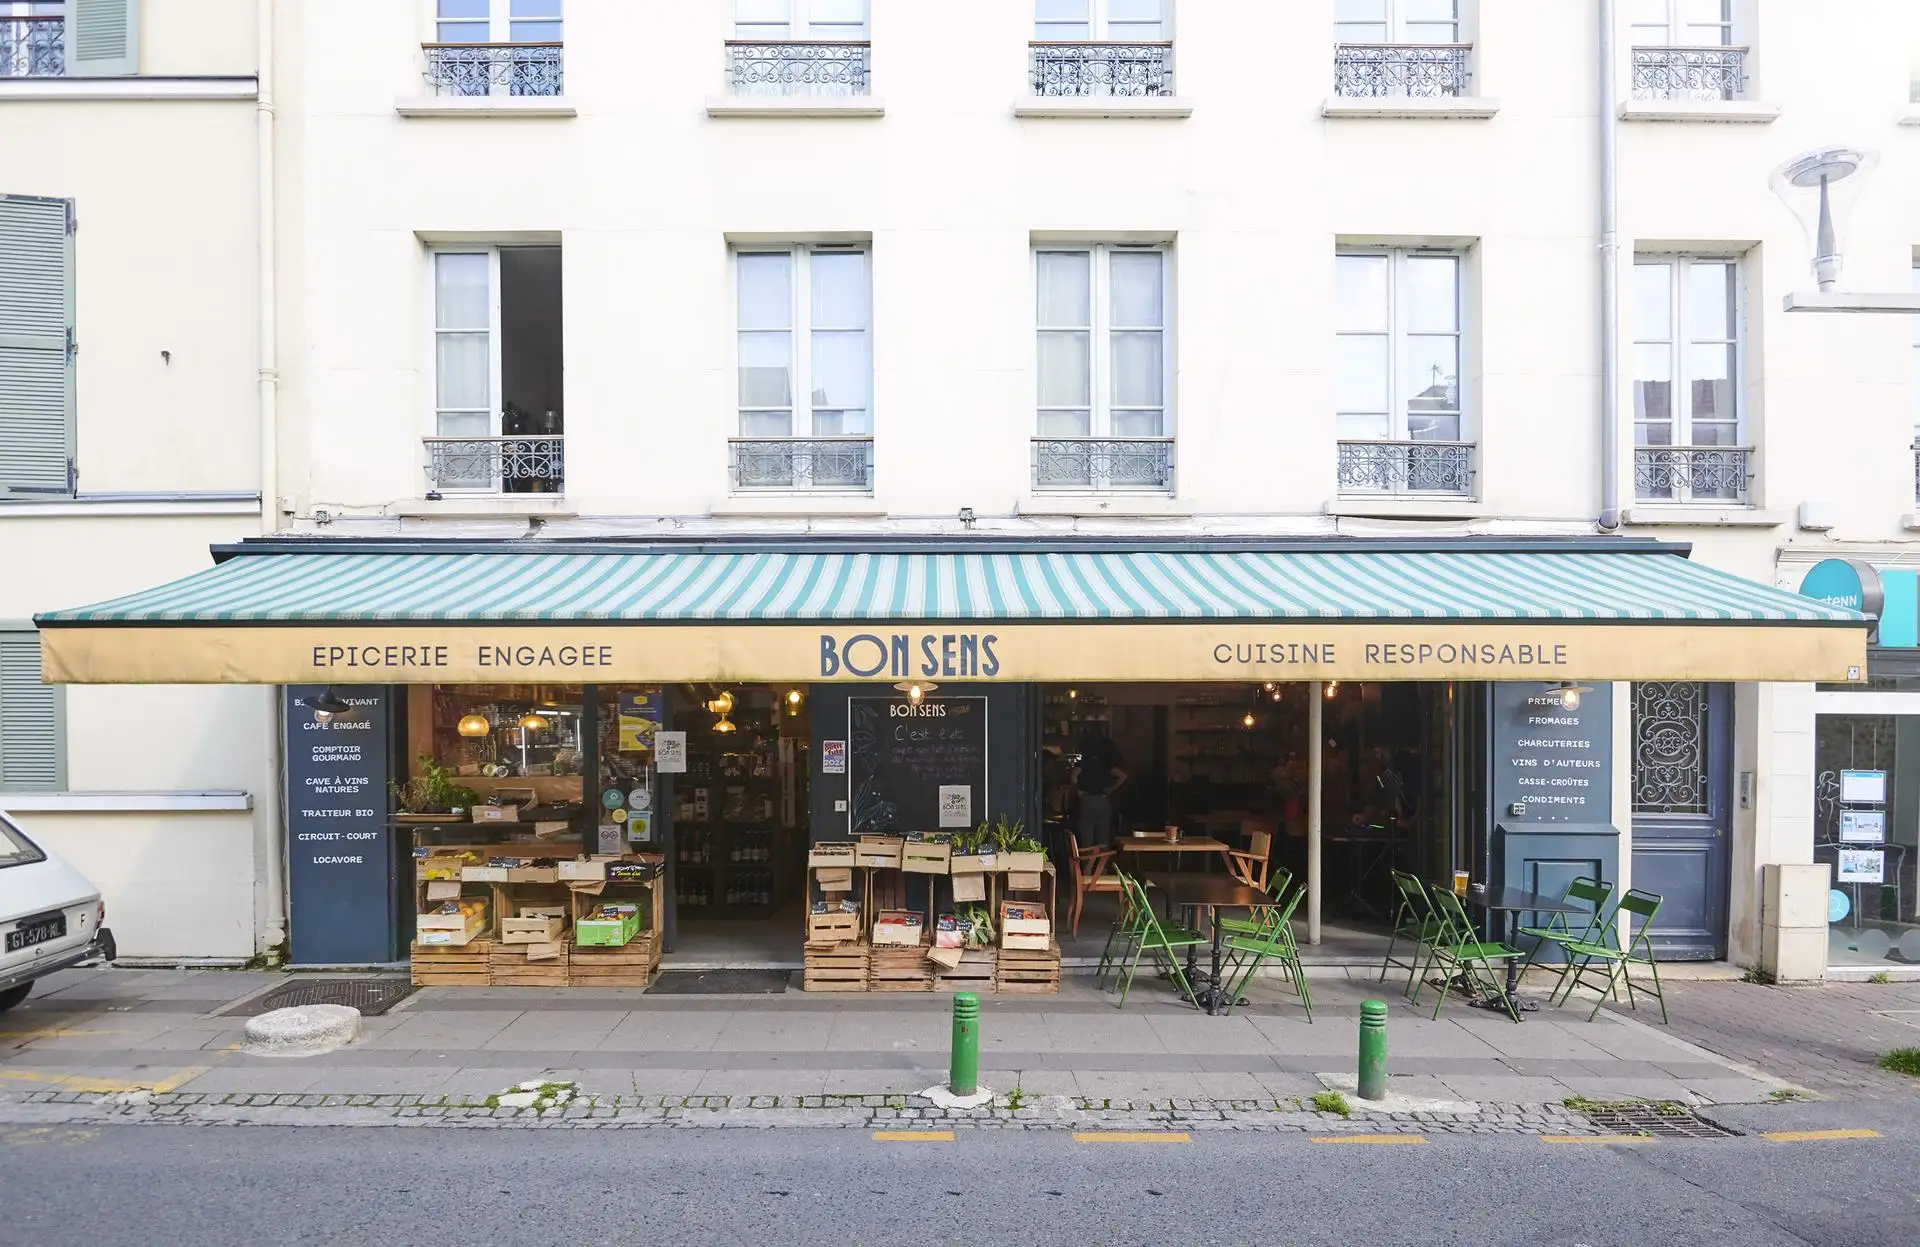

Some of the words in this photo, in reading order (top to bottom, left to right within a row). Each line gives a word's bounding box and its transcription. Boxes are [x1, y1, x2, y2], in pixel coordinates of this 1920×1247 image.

[313, 646, 448, 666] EPICERIE
[478, 646, 613, 666] ENGAGEE
[820, 634, 909, 677] BON
[921, 634, 1000, 677] SENS
[1213, 644, 1336, 664] CUISINE
[1365, 644, 1567, 665] RESPONSABLE
[342, 698, 379, 706] VIVANT
[1528, 697, 1567, 706] PRIME
[890, 704, 917, 717] BON
[920, 704, 946, 717] SENS
[333, 720, 372, 730] ENGAGÉ
[1528, 717, 1580, 725] FROMAGES
[1518, 740, 1591, 748] CHARCUTERIES
[312, 746, 361, 754] COMPTOIR
[312, 754, 361, 762] GOURMAND
[1512, 759, 1538, 767] VINS
[1544, 759, 1601, 768] D'AUTEURS
[305, 777, 331, 785] CAVE
[334, 775, 342, 785] À
[344, 777, 369, 785] VINS
[1518, 777, 1589, 787] CASSE-CROÛTES
[315, 785, 359, 794] NATURES
[1521, 796, 1586, 804] CONDIMENTS
[301, 809, 351, 817] TRAITEUR
[355, 809, 374, 817] BIO
[313, 856, 363, 864] LOCAVORE
[80, 913, 86, 929] F
